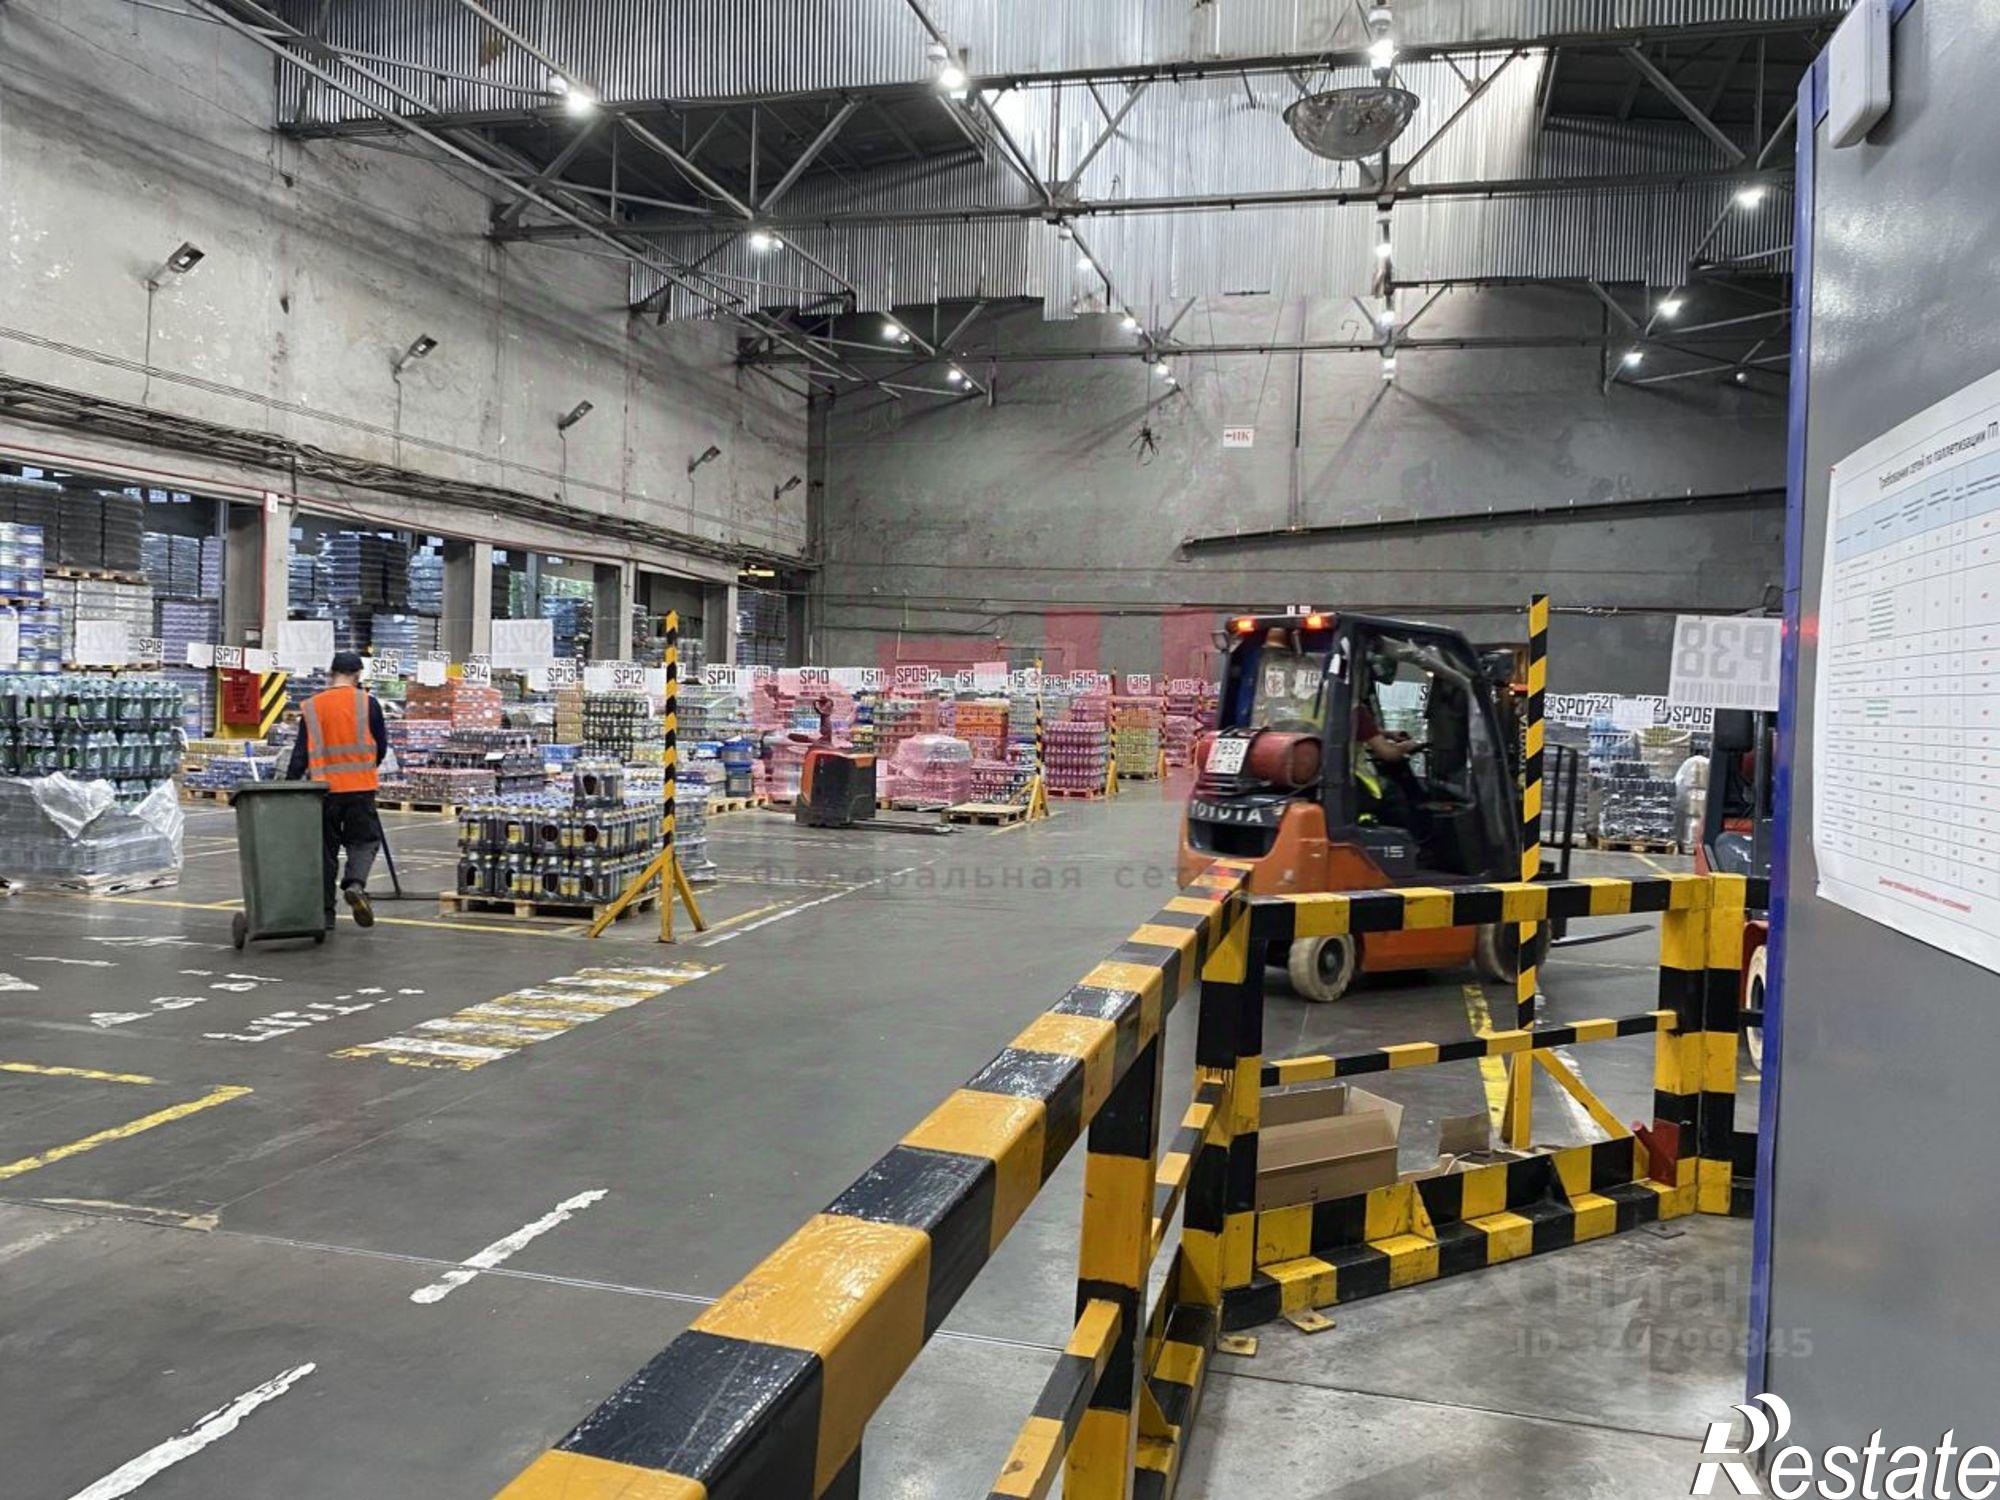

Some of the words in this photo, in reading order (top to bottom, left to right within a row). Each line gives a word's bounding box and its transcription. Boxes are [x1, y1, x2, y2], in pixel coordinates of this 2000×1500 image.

[216, 646, 241, 662] SP17
[372, 659, 398, 674] SP15
[463, 664, 488, 679] SP14
[547, 667, 576, 683] SP13
[614, 669, 642, 684] SP12
[708, 670, 735, 685] SP11
[800, 669, 829, 685] SP10
[861, 669, 884, 683] 1511
[897, 667, 928, 683] SP09
[960, 671, 974, 684] 151
[1072, 672, 1095, 685] 1515
[1557, 697, 1594, 715] SP07
[1672, 706, 1712, 725] SP06
